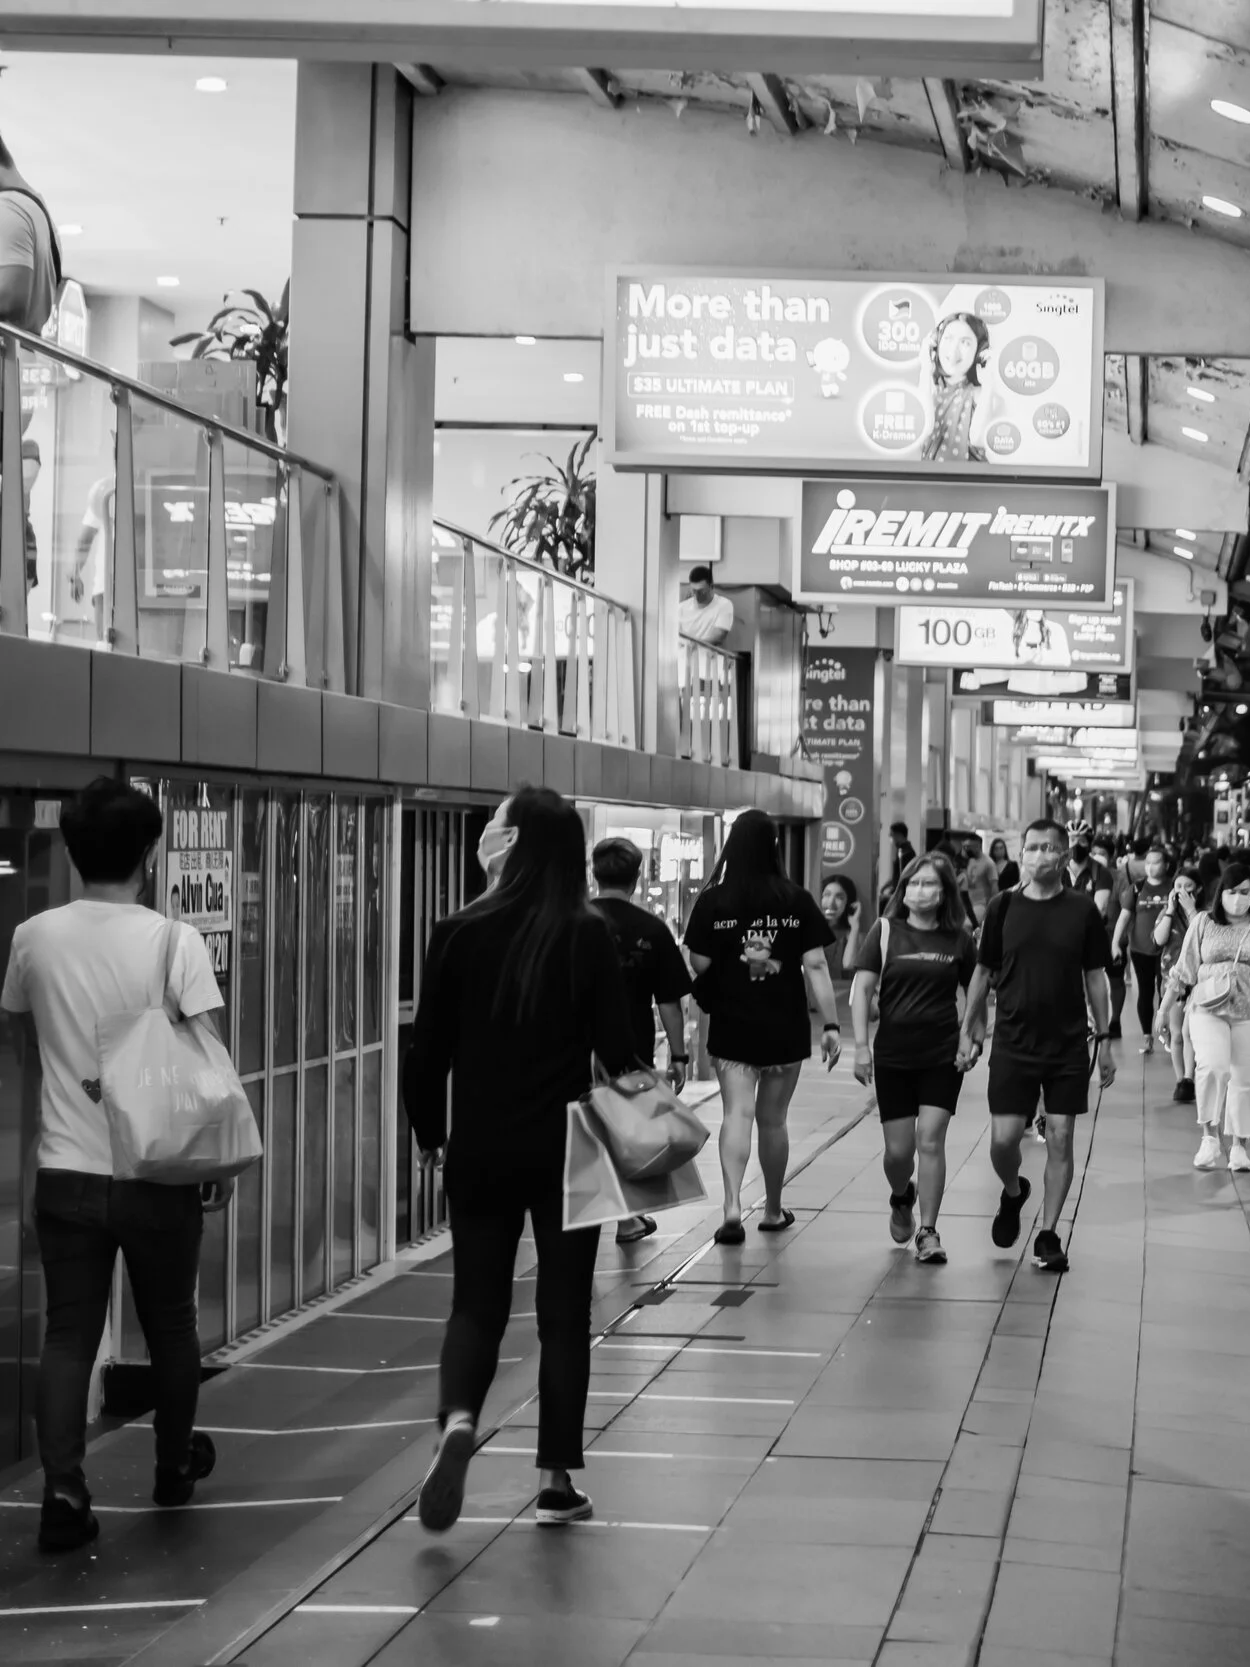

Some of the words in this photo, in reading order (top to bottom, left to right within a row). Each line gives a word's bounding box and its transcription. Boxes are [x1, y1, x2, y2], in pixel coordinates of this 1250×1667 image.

[629, 283, 732, 319] More
[743, 286, 831, 322] than
[1035, 302, 1081, 317] Singtel
[878, 320, 920, 342] 300
[624, 324, 698, 367] just
[709, 326, 796, 361] data
[1003, 361, 1055, 379] 60GB
[633, 376, 662, 393] $35
[666, 378, 741, 395] ULTIMATE
[745, 380, 788, 396] PLAN
[636, 404, 671, 418] FREE
[675, 405, 709, 420] Dash
[668, 421, 685, 433] on
[690, 420, 710, 433] 1st
[713, 421, 760, 437] top-up
[874, 414, 915, 430] FREE
[872, 430, 916, 441] K-Dramas
[829, 559, 859, 571] SHOP
[895, 561, 931, 574] LUCKY
[933, 562, 968, 575] PLAZA
[917, 618, 973, 646] 100
[828, 694, 870, 711] than
[823, 713, 865, 731] data
[806, 738, 836, 746] TIMATE
[173, 810, 199, 849] FOR
[201, 811, 228, 849] RENT
[713, 918, 738, 930] acm
[766, 915, 778, 928] la
[781, 915, 800, 928] vie
[137, 1067, 153, 1089] JE
[160, 1065, 180, 1088] NE
